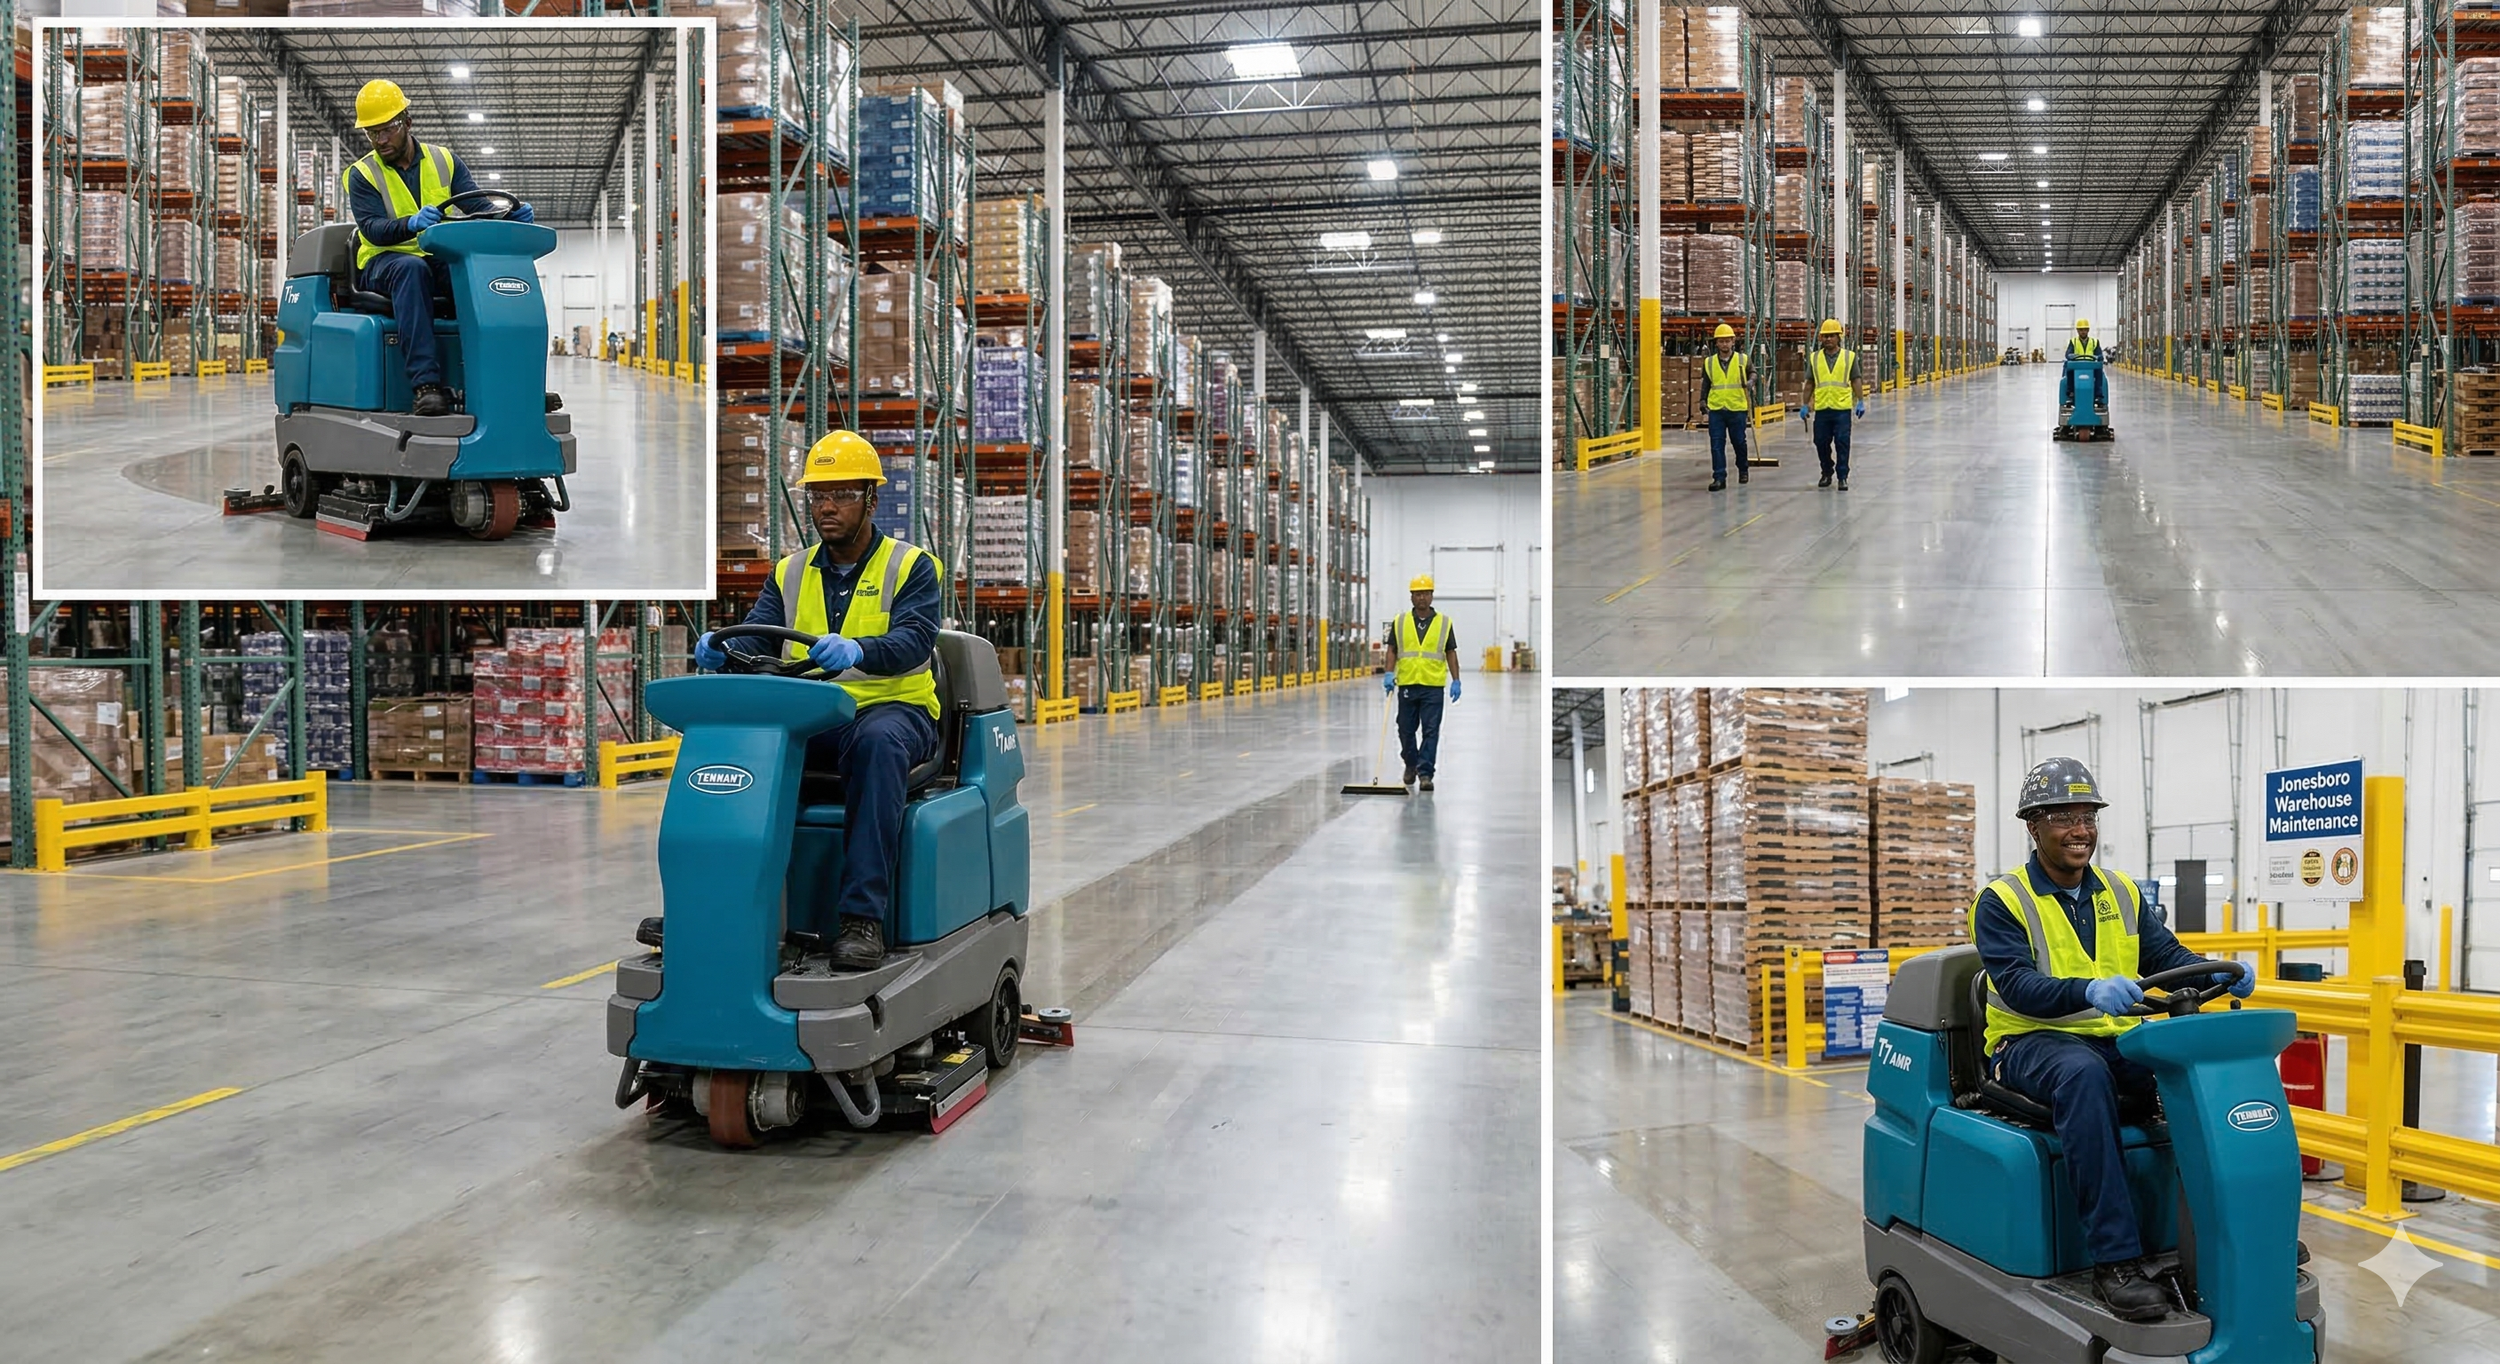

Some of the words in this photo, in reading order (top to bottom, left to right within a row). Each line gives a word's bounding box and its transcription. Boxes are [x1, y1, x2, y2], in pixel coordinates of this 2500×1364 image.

[696, 772, 746, 787] TENNANT
[2277, 771, 2351, 793] Jonesboro
[2274, 793, 2353, 813] Warehouse
[2269, 814, 2359, 834] Maintenance
[1878, 1037, 1893, 1065] T7
[1889, 1051, 1912, 1072] AMR
